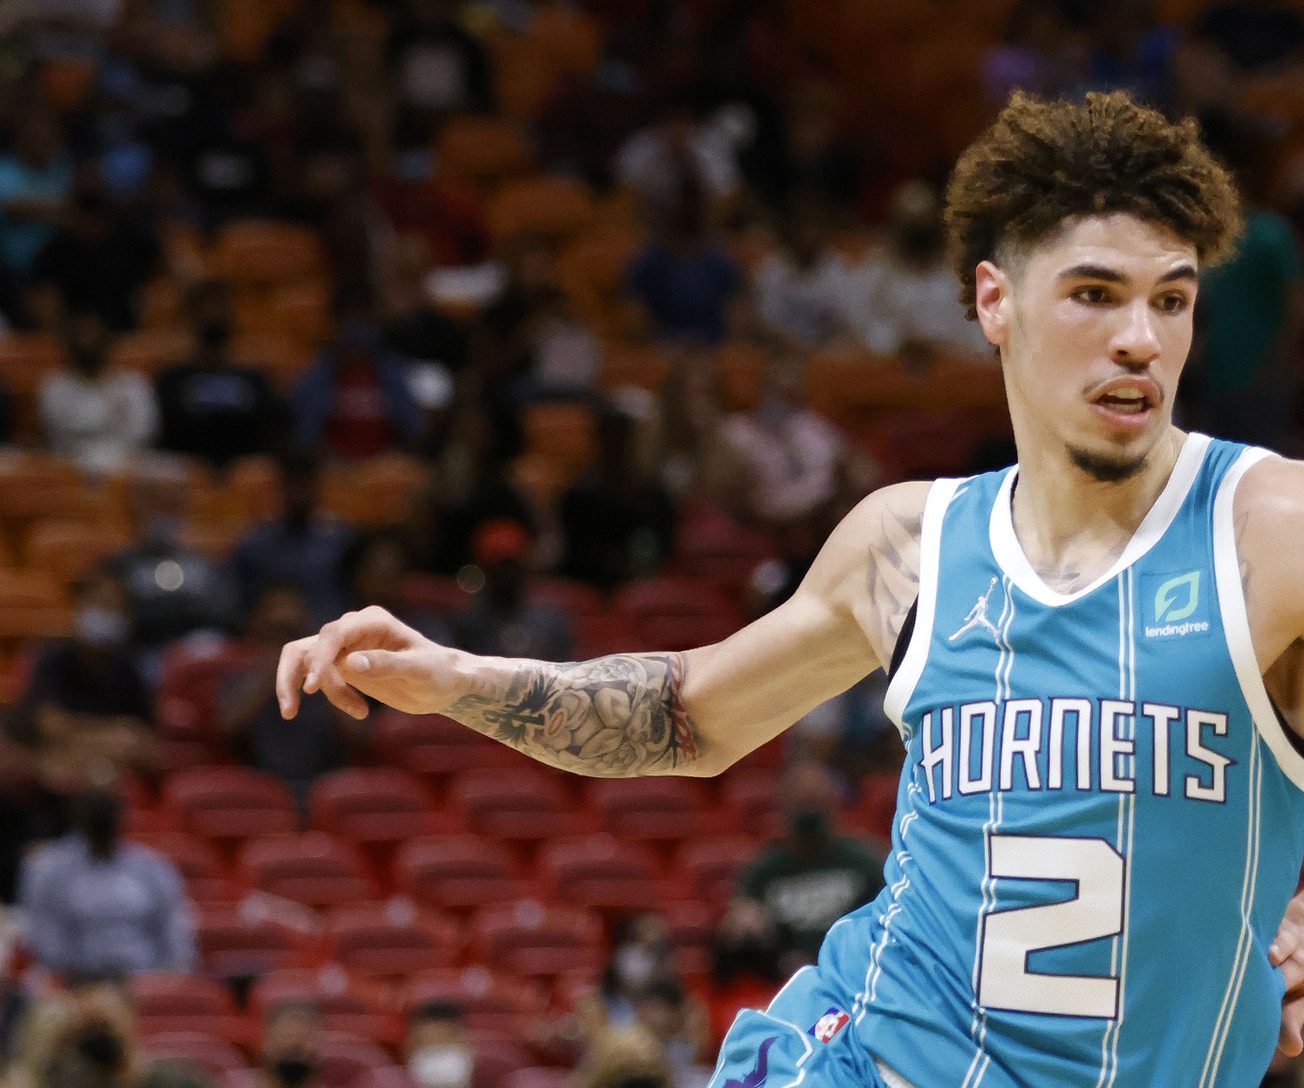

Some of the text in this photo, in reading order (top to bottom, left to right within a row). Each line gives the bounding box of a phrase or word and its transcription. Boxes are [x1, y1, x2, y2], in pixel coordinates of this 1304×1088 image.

[1145, 621, 1209, 638] lendingtree
[919, 696, 1238, 806] HORNETS
[976, 832, 1126, 1020] 2
